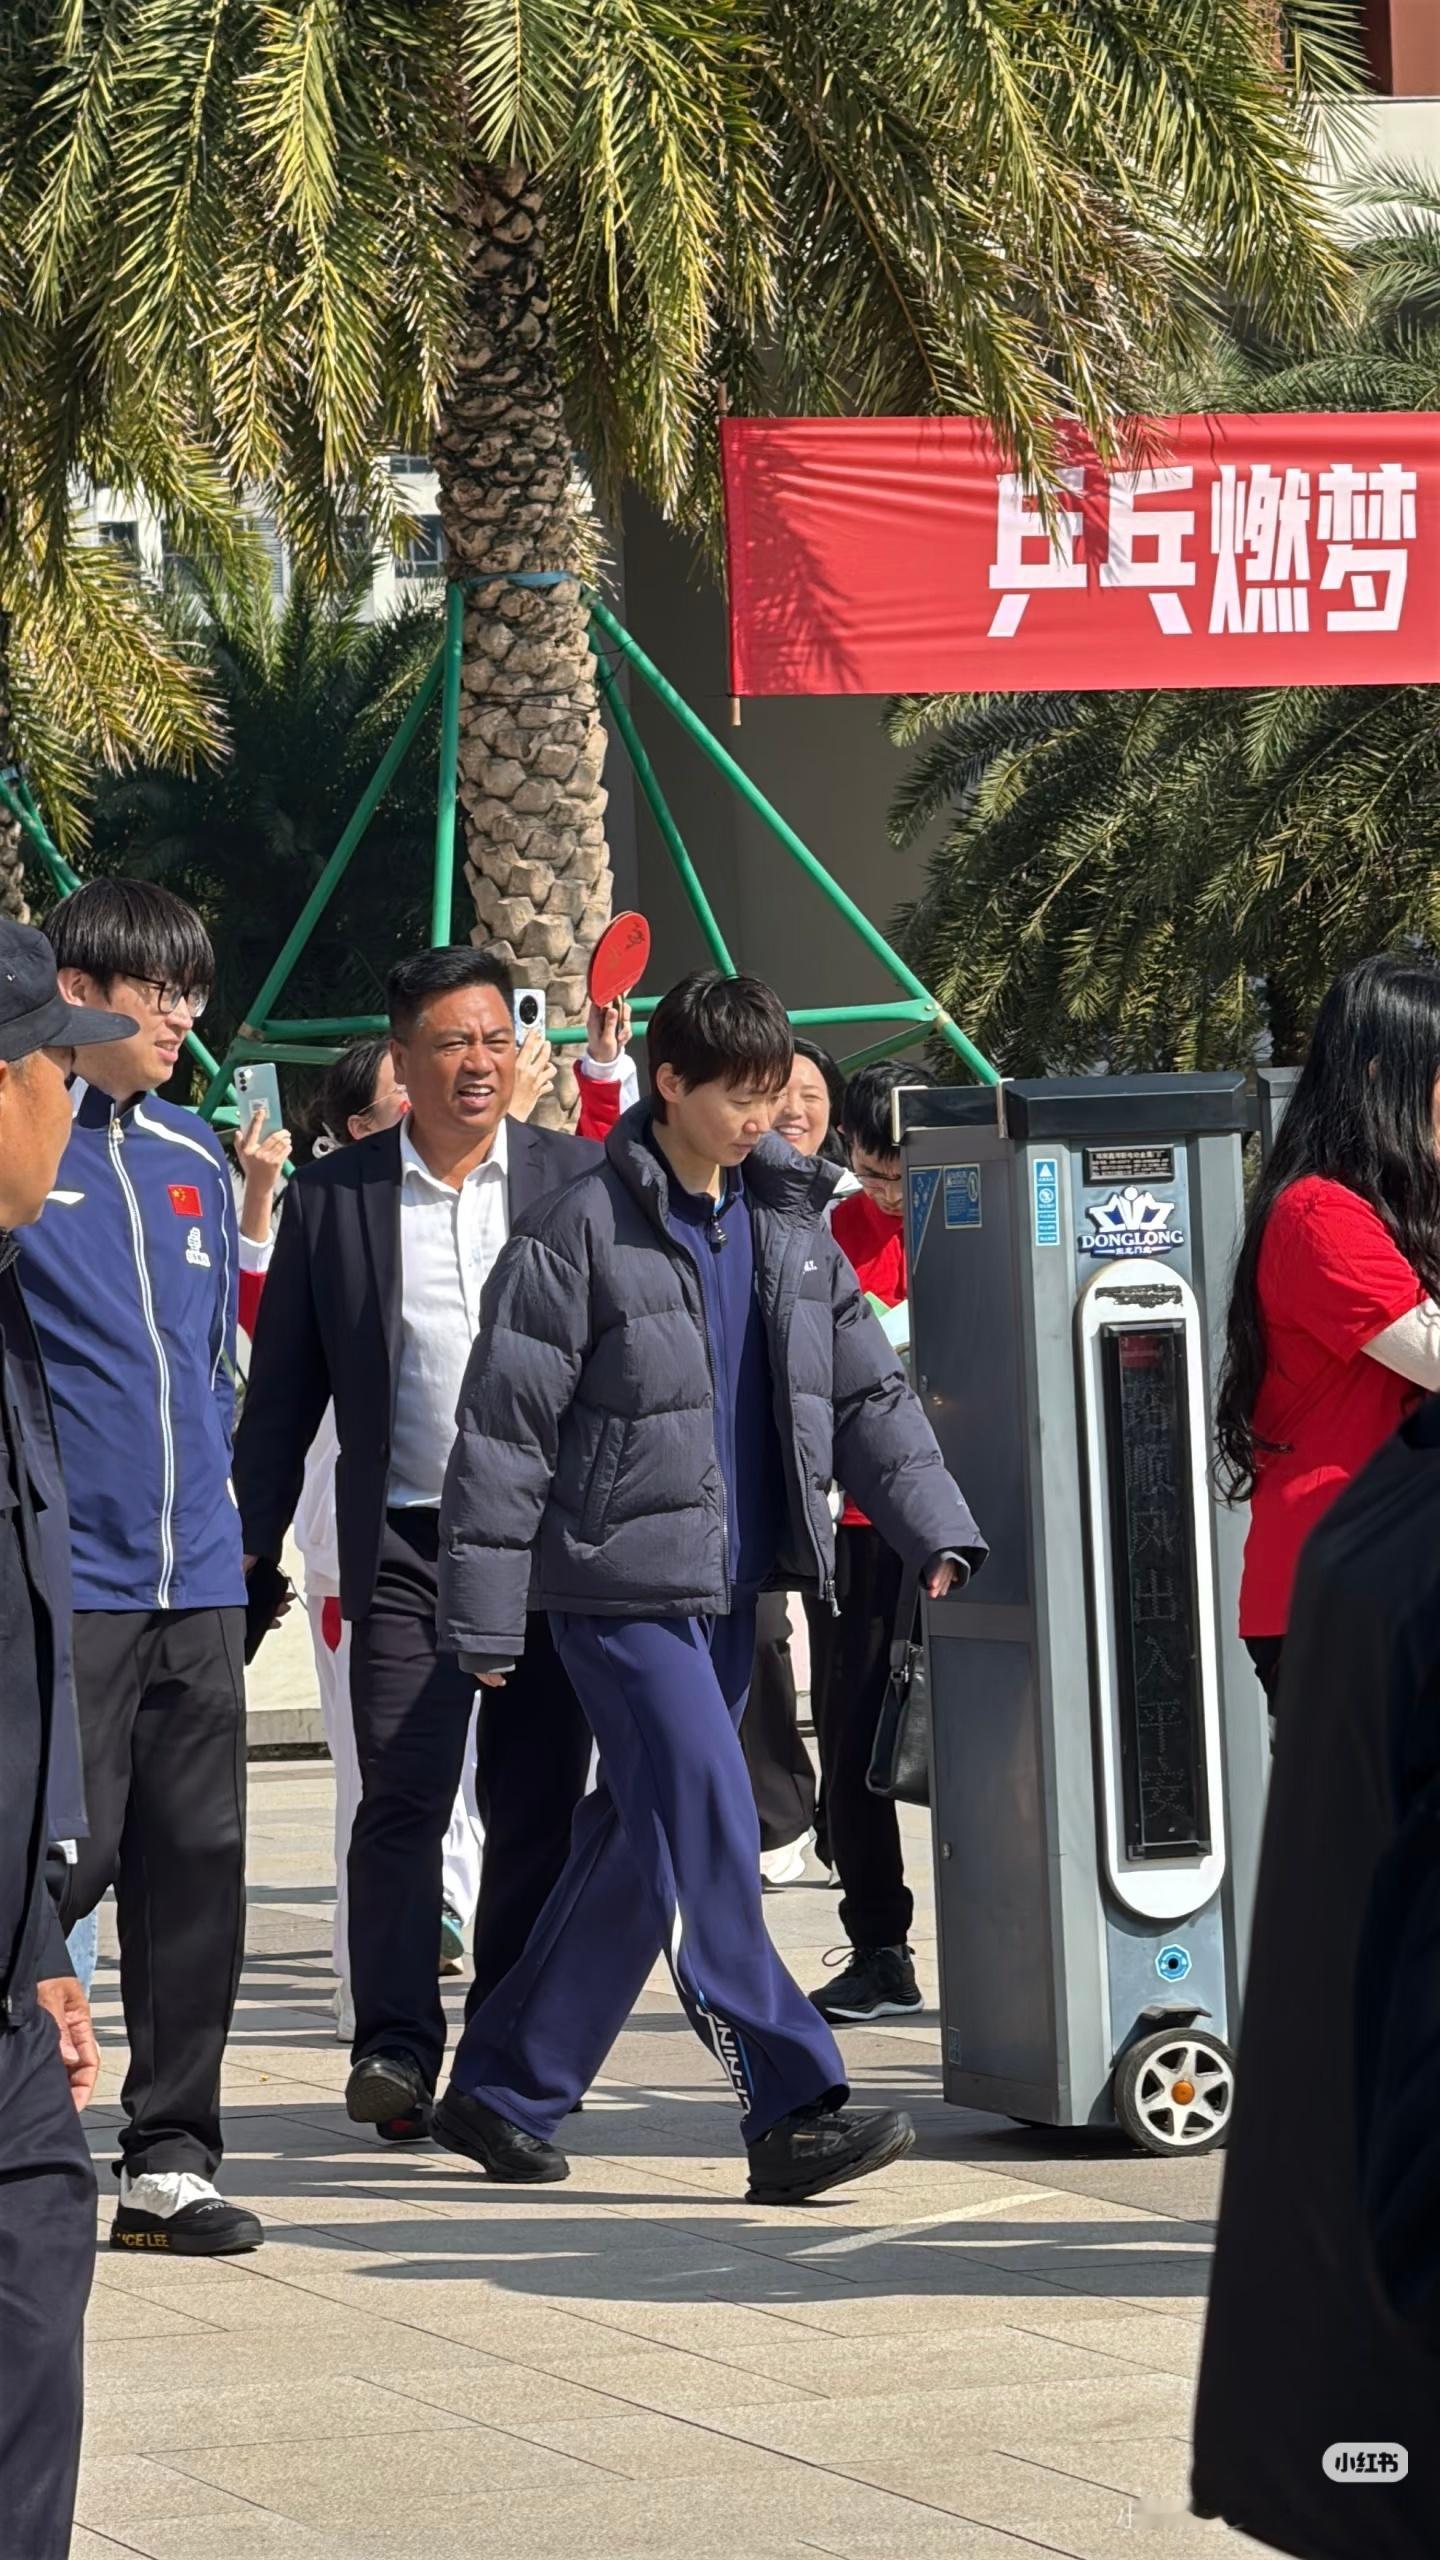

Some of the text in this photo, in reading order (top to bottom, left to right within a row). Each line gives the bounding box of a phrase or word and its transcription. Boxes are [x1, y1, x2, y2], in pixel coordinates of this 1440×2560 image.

[987, 464, 1417, 637] 乒乓燃梦
[1082, 1230, 1184, 1248] DONGLONG
[147, 2233, 168, 2247] LEE
